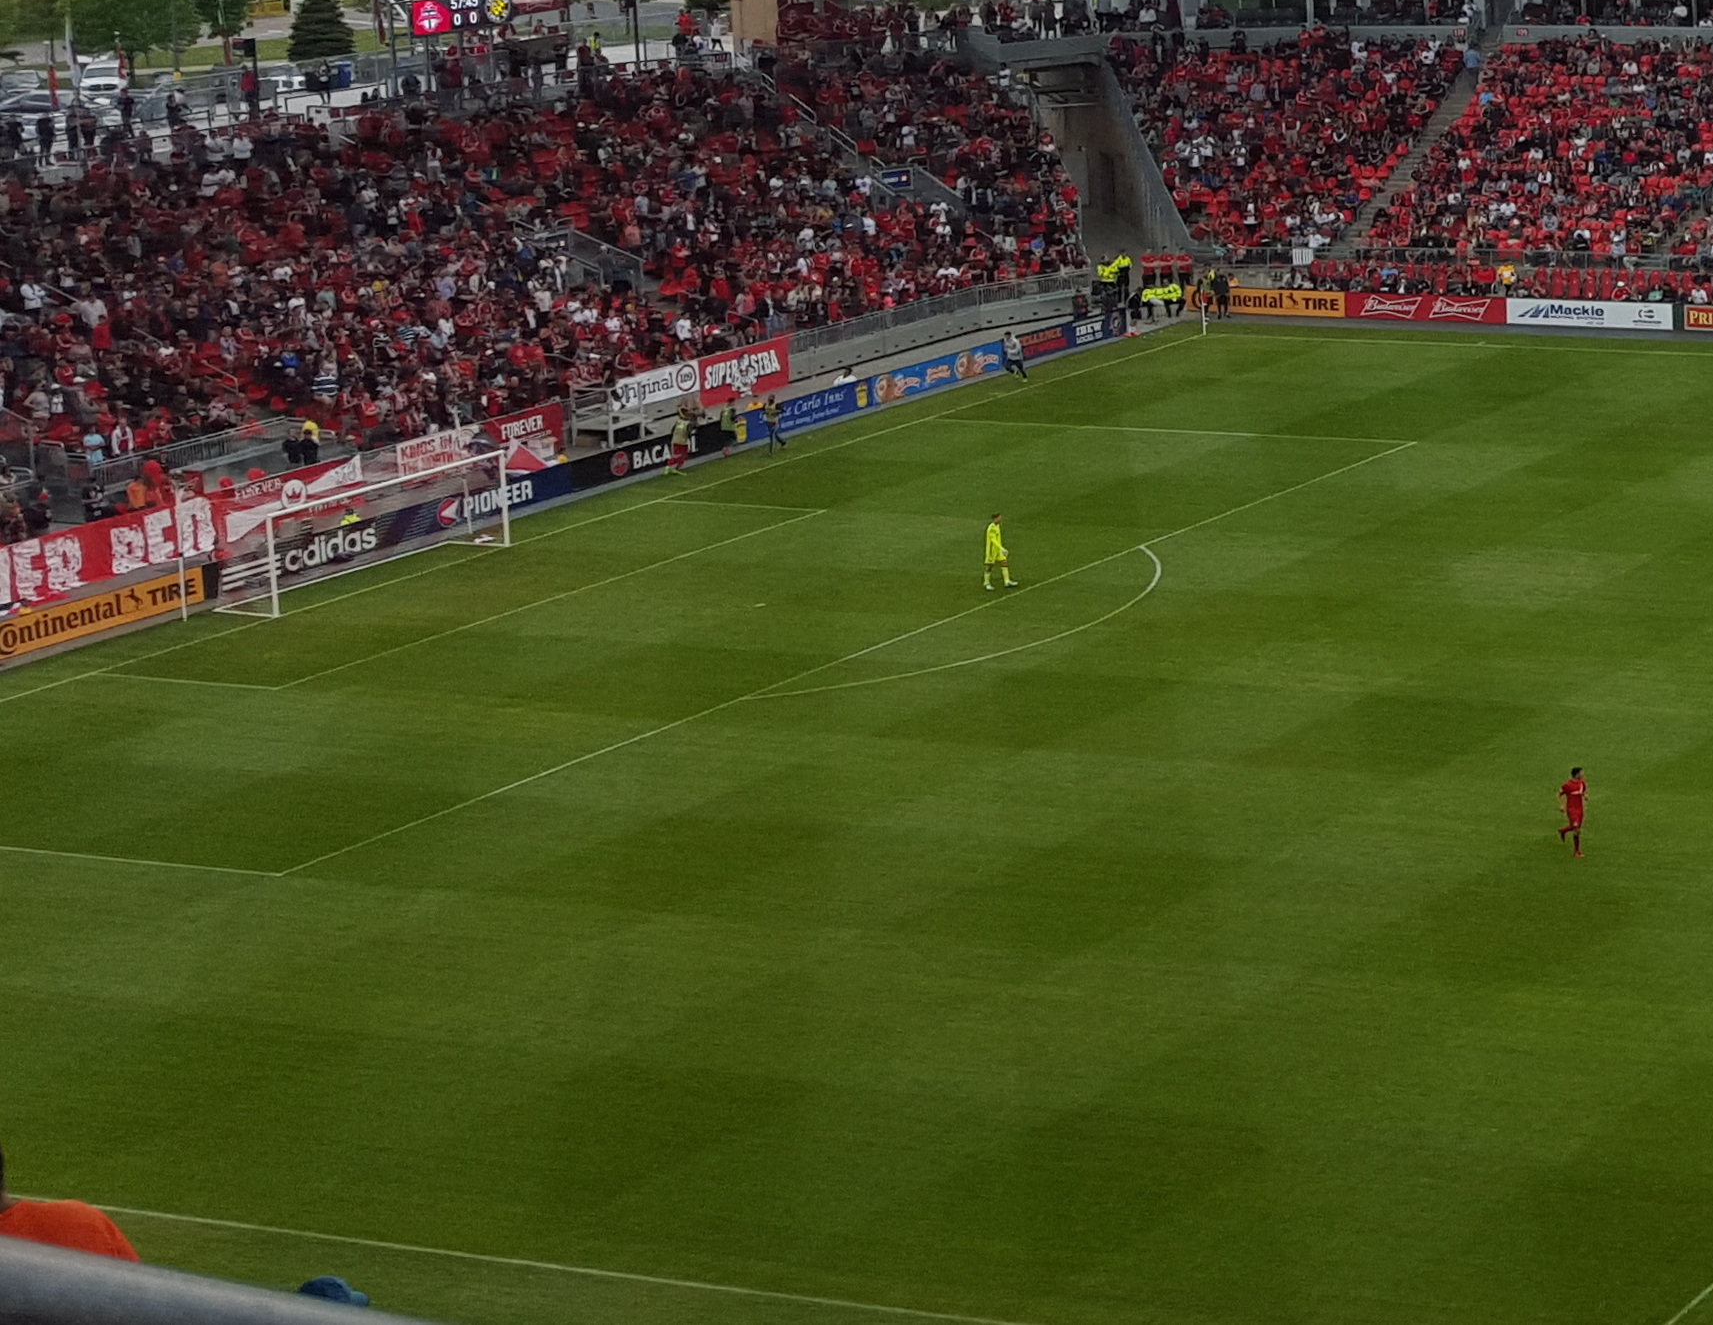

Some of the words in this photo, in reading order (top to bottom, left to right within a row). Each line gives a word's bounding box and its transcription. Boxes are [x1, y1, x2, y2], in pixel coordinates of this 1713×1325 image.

[453, 12, 461, 26] 0
[469, 11, 478, 24] 0
[1302, 297, 1340, 311] TIRE
[1366, 297, 1416, 313] Budweiser
[1435, 298, 1485, 314] Budweiser
[704, 359, 743, 389] SUPER
[750, 350, 781, 376] SEBA
[794, 393, 822, 416] Carlo
[501, 414, 545, 441] FOREVER
[463, 479, 533, 518] PIONEER
[111, 496, 217, 575] RED
[285, 524, 378, 573] adidas
[0, 593, 123, 656] Continental
[146, 577, 197, 607] TIRE
